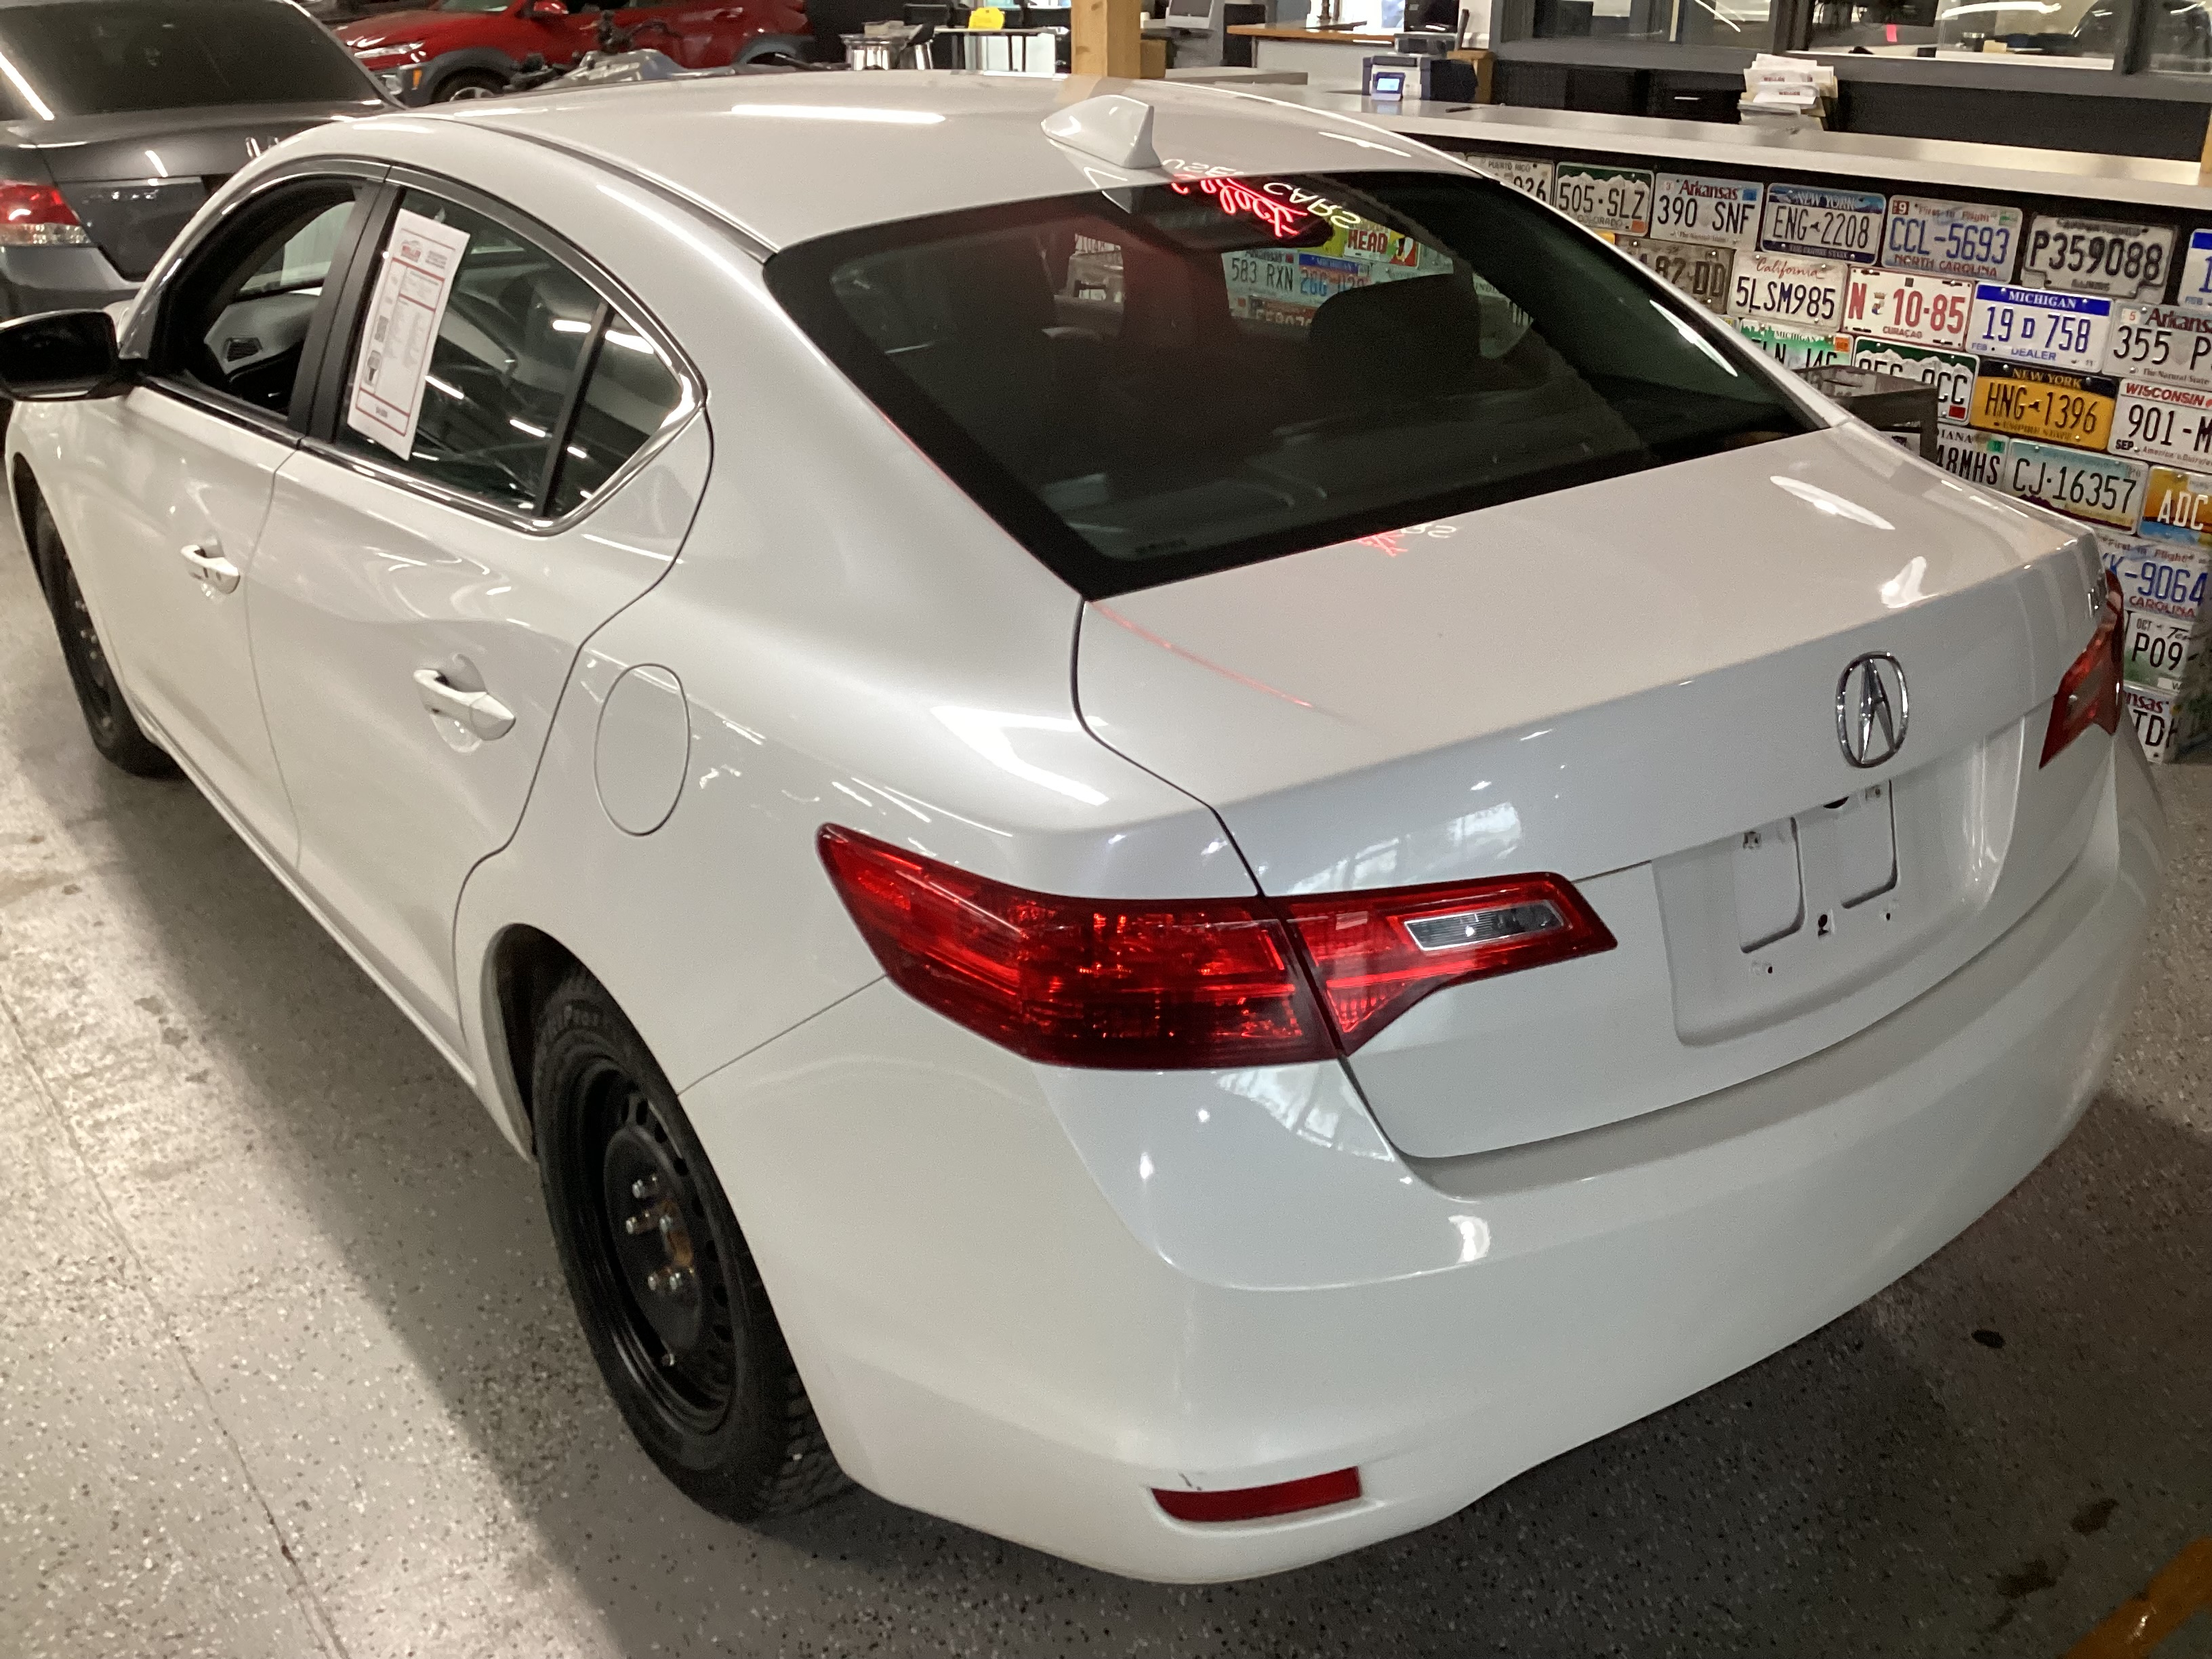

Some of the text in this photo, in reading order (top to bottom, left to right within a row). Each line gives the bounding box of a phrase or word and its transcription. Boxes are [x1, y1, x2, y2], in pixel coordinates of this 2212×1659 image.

[1679, 179, 1739, 201] Arkansas
[1658, 194, 1755, 234] 390 SNF
[1889, 217, 2011, 265] CCL-5693
[1893, 253, 1998, 277] NORTH CAROLINA
[2030, 230, 2163, 281] P359088
[1231, 258, 1294, 291] 583 RXN
[1756, 257, 1825, 279] California
[1736, 276, 1837, 320] 5LSM985
[1847, 282, 1867, 320] N
[2008, 290, 2077, 309] MICHIGAN
[1982, 304, 2015, 342] 19
[2045, 312, 2091, 354] 758
[2010, 347, 2057, 361] DEALER
[2113, 325, 2174, 365] 355
[2011, 367, 2083, 389] NEW YORK
[2125, 382, 2206, 407] WISCONSIN
[1937, 428, 1973, 444] IANA
[2115, 438, 2135, 451] SEP
[2129, 596, 2196, 618] CAROLINA
[2136, 618, 2152, 632] OCT
